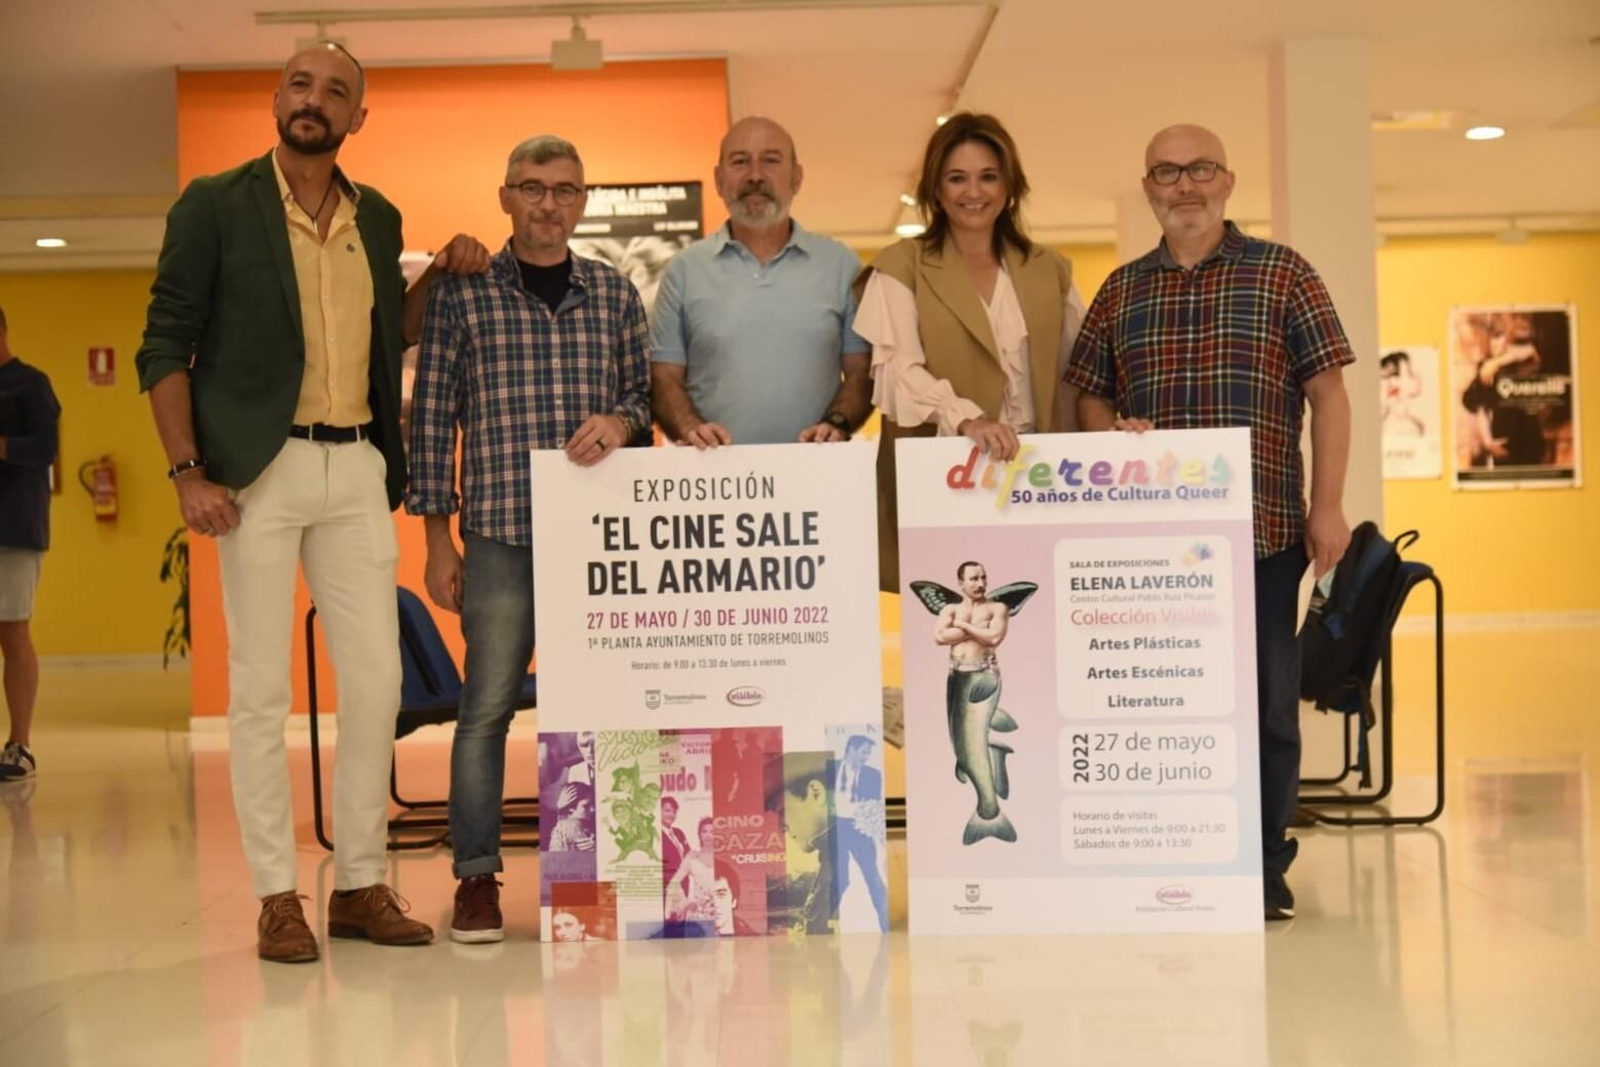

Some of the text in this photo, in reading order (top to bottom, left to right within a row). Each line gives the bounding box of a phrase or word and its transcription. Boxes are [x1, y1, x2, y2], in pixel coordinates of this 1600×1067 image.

[946, 443, 1232, 510] diferentes
[633, 471, 776, 503] EXPOSICIÓN
[1011, 485, 1229, 504] 50 años de Cultura Queer
[650, 514, 726, 550] CINE
[736, 511, 819, 548] SALE
[1070, 559, 1170, 569] SALA DE EXPOSICIONES
[587, 560, 648, 595] DEL
[1070, 571, 1213, 591] ELENA LAVERÓN
[1070, 594, 1099, 604] Centro
[1101, 593, 1134, 603] Cultural
[1137, 593, 1162, 602] Pablo
[587, 606, 829, 630] 27 DE MAYO / 30 DE JUNIO 2022
[1071, 608, 1157, 626] Colección
[602, 636, 643, 650] PLANTA
[646, 634, 727, 649] AYUNTAMIENTO
[731, 633, 744, 647] DE
[748, 631, 830, 646] TORREMOLINOS
[1089, 635, 1201, 652] Artes Plásticas
[631, 660, 661, 671] Horario:
[663, 660, 672, 669] de
[719, 659, 729, 668] de
[730, 658, 751, 668] lunes
[760, 658, 787, 667] viernes
[1087, 664, 1205, 680] Artes Escénicas
[1108, 694, 1185, 709] Literatura
[1095, 732, 1216, 754] 27 de mayo
[1072, 733, 1090, 784] 2022
[1095, 761, 1212, 784] 30 de junio
[713, 814, 764, 830] CINO
[1073, 810, 1158, 821] Horario de visitas
[1073, 825, 1103, 835] Lunes
[1113, 824, 1150, 834] Viernes
[1151, 824, 1164, 834] de
[1166, 824, 1187, 834] 9:00
[1074, 837, 1192, 849] Sábados de 9:00 a 13:30
